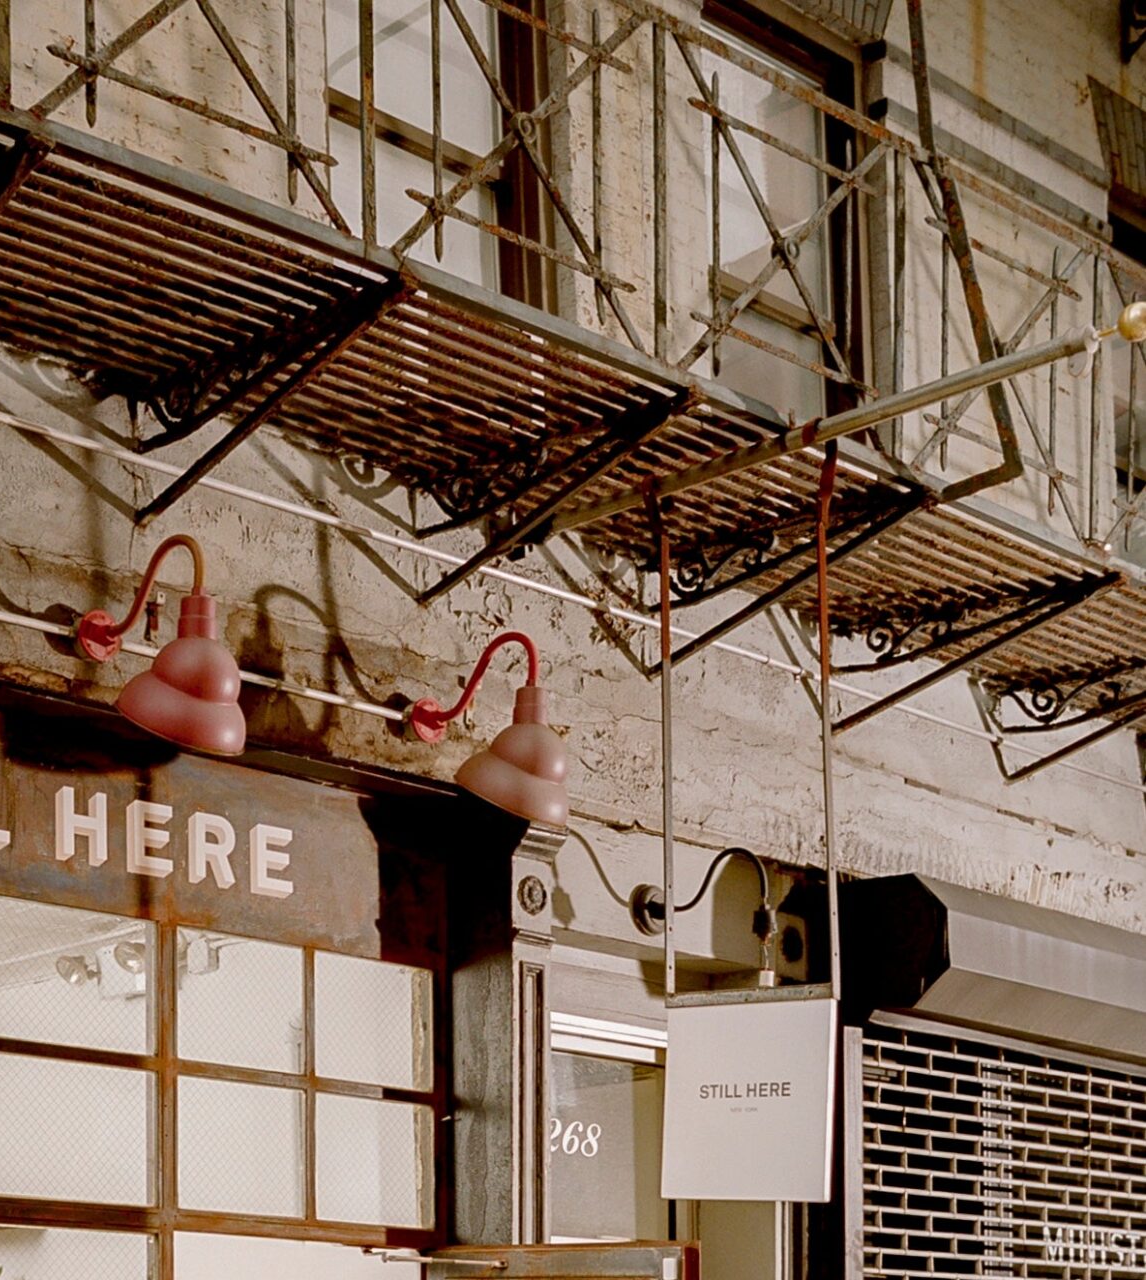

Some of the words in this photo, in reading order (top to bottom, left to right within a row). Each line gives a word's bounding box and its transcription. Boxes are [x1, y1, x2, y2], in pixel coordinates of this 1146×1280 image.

[55, 785, 294, 899] HERE
[699, 1083, 743, 1099] STILL
[746, 1081, 792, 1098] HERE
[549, 1117, 602, 1158] 268
[1043, 1225, 1146, 1270] MINIST
